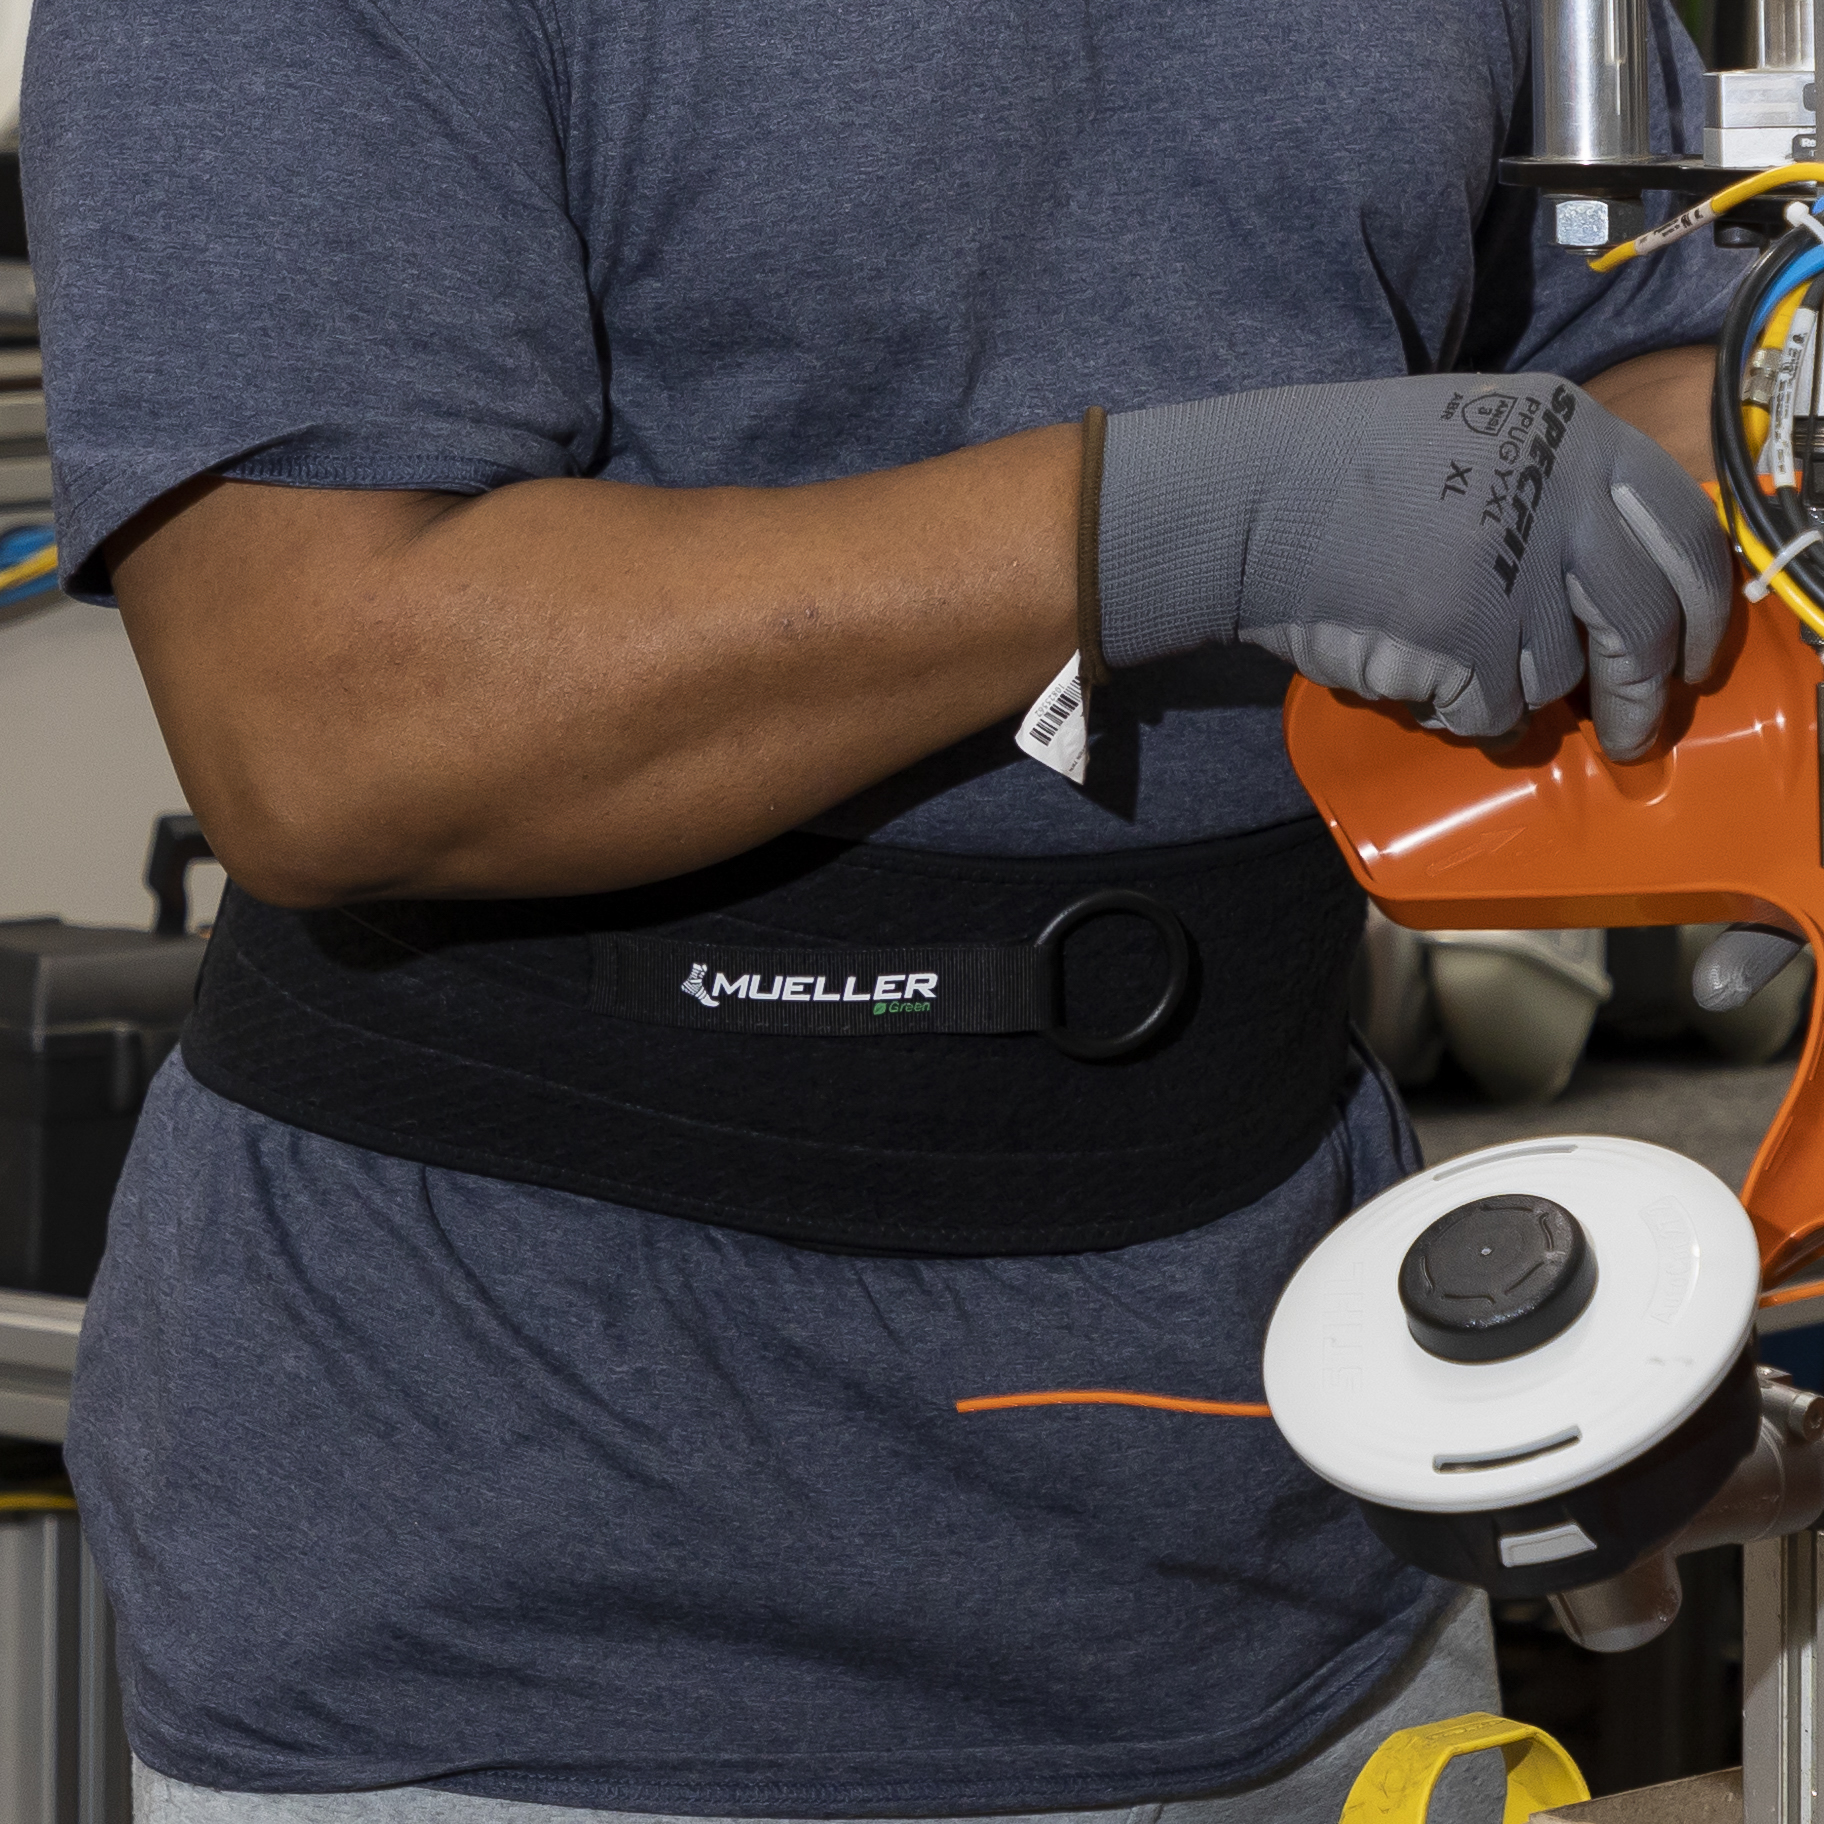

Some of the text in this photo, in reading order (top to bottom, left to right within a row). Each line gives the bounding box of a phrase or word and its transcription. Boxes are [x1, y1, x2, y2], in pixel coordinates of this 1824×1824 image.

[1438, 460, 1473, 502] XL
[1493, 383, 1576, 598] SPECFIT
[711, 972, 939, 1001] MUELLER
[888, 1001, 931, 1013] Green
